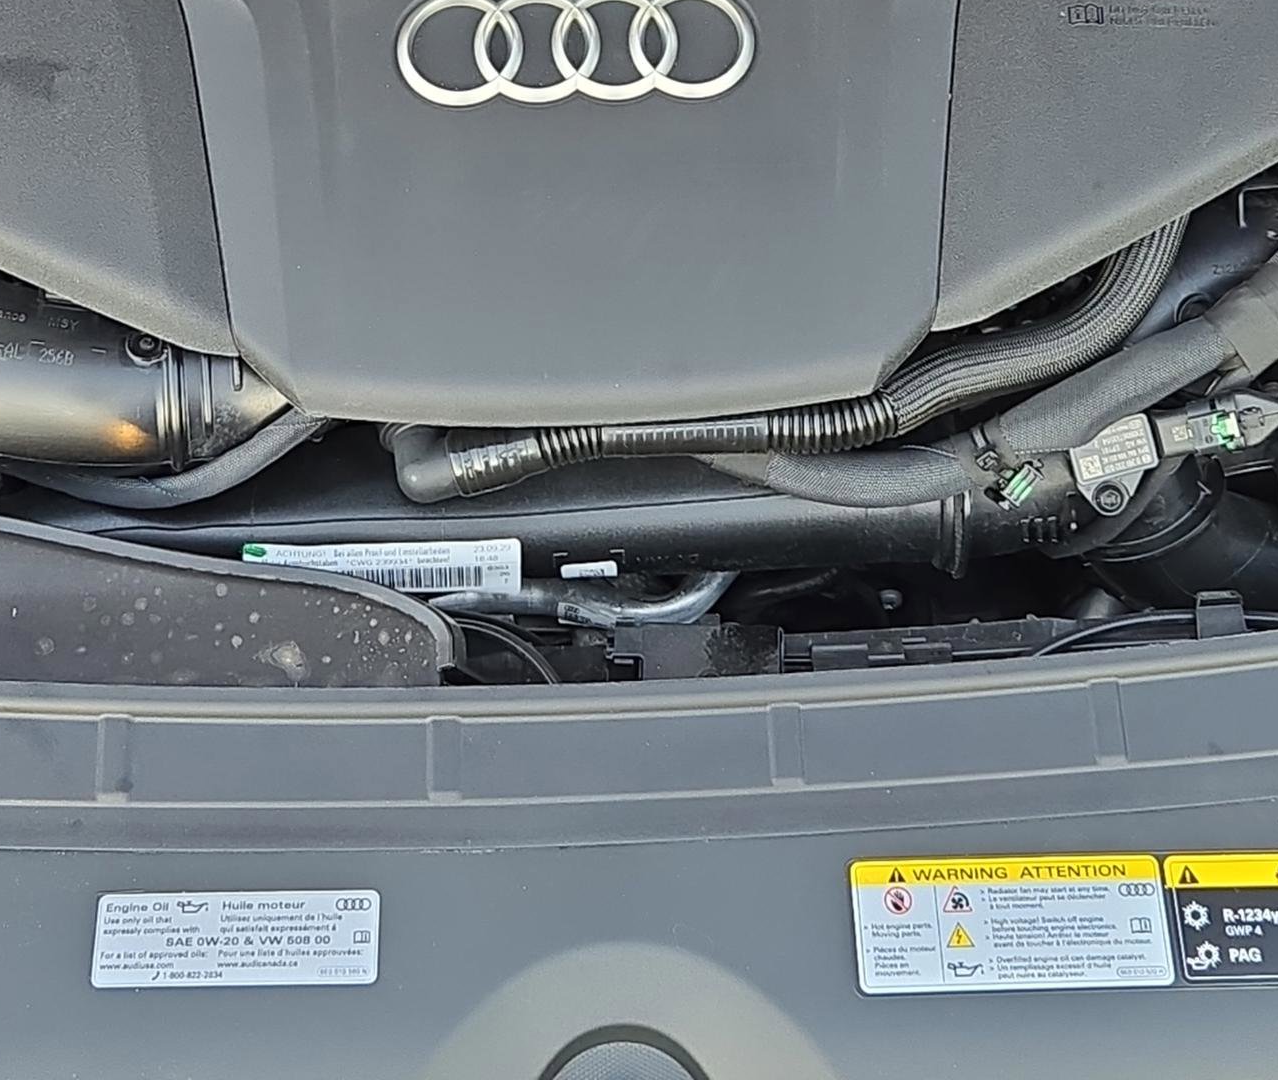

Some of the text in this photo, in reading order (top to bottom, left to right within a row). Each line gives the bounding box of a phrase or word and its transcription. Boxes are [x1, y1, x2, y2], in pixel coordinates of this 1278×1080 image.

[913, 864, 1127, 881] WARNING ATTENTION
[987, 887, 1018, 895] Radiator
[1033, 887, 1050, 895] may
[1078, 886, 1095, 894] any
[1039, 894, 1057, 902] peut
[106, 902, 170, 913] Engine Oil
[222, 901, 305, 910] Huile moteur
[122, 917, 140, 925] only
[142, 916, 154, 924] oil
[252, 914, 303, 924] uniquement
[990, 918, 1008, 926] High
[1079, 916, 1104, 924] engine
[103, 925, 201, 936] expressly complies with
[220, 925, 234, 934] qui
[871, 923, 885, 931] Hot
[886, 923, 912, 932] engine
[992, 924, 1016, 932] before
[1017, 924, 1049, 933] touching
[1050, 924, 1076, 932] engine
[1225, 924, 1265, 937] GWP 4
[871, 931, 900, 939] Moving
[165, 935, 332, 947] SAE 0W-20 & VW 508 00
[1025, 939, 1054, 947] toucher
[100, 951, 114, 959] For
[149, 950, 189, 959] approved
[218, 949, 238, 958] Pour
[257, 948, 275, 957] liste
[1228, 948, 1263, 963] PAG
[996, 954, 1032, 963] Overfilled
[1033, 954, 1059, 963] engine
[1086, 953, 1116, 962] damage
[100, 962, 175, 970] www.audiusa.com
[217, 959, 298, 968] www.audicanada.ca
[998, 970, 1016, 978] peut
